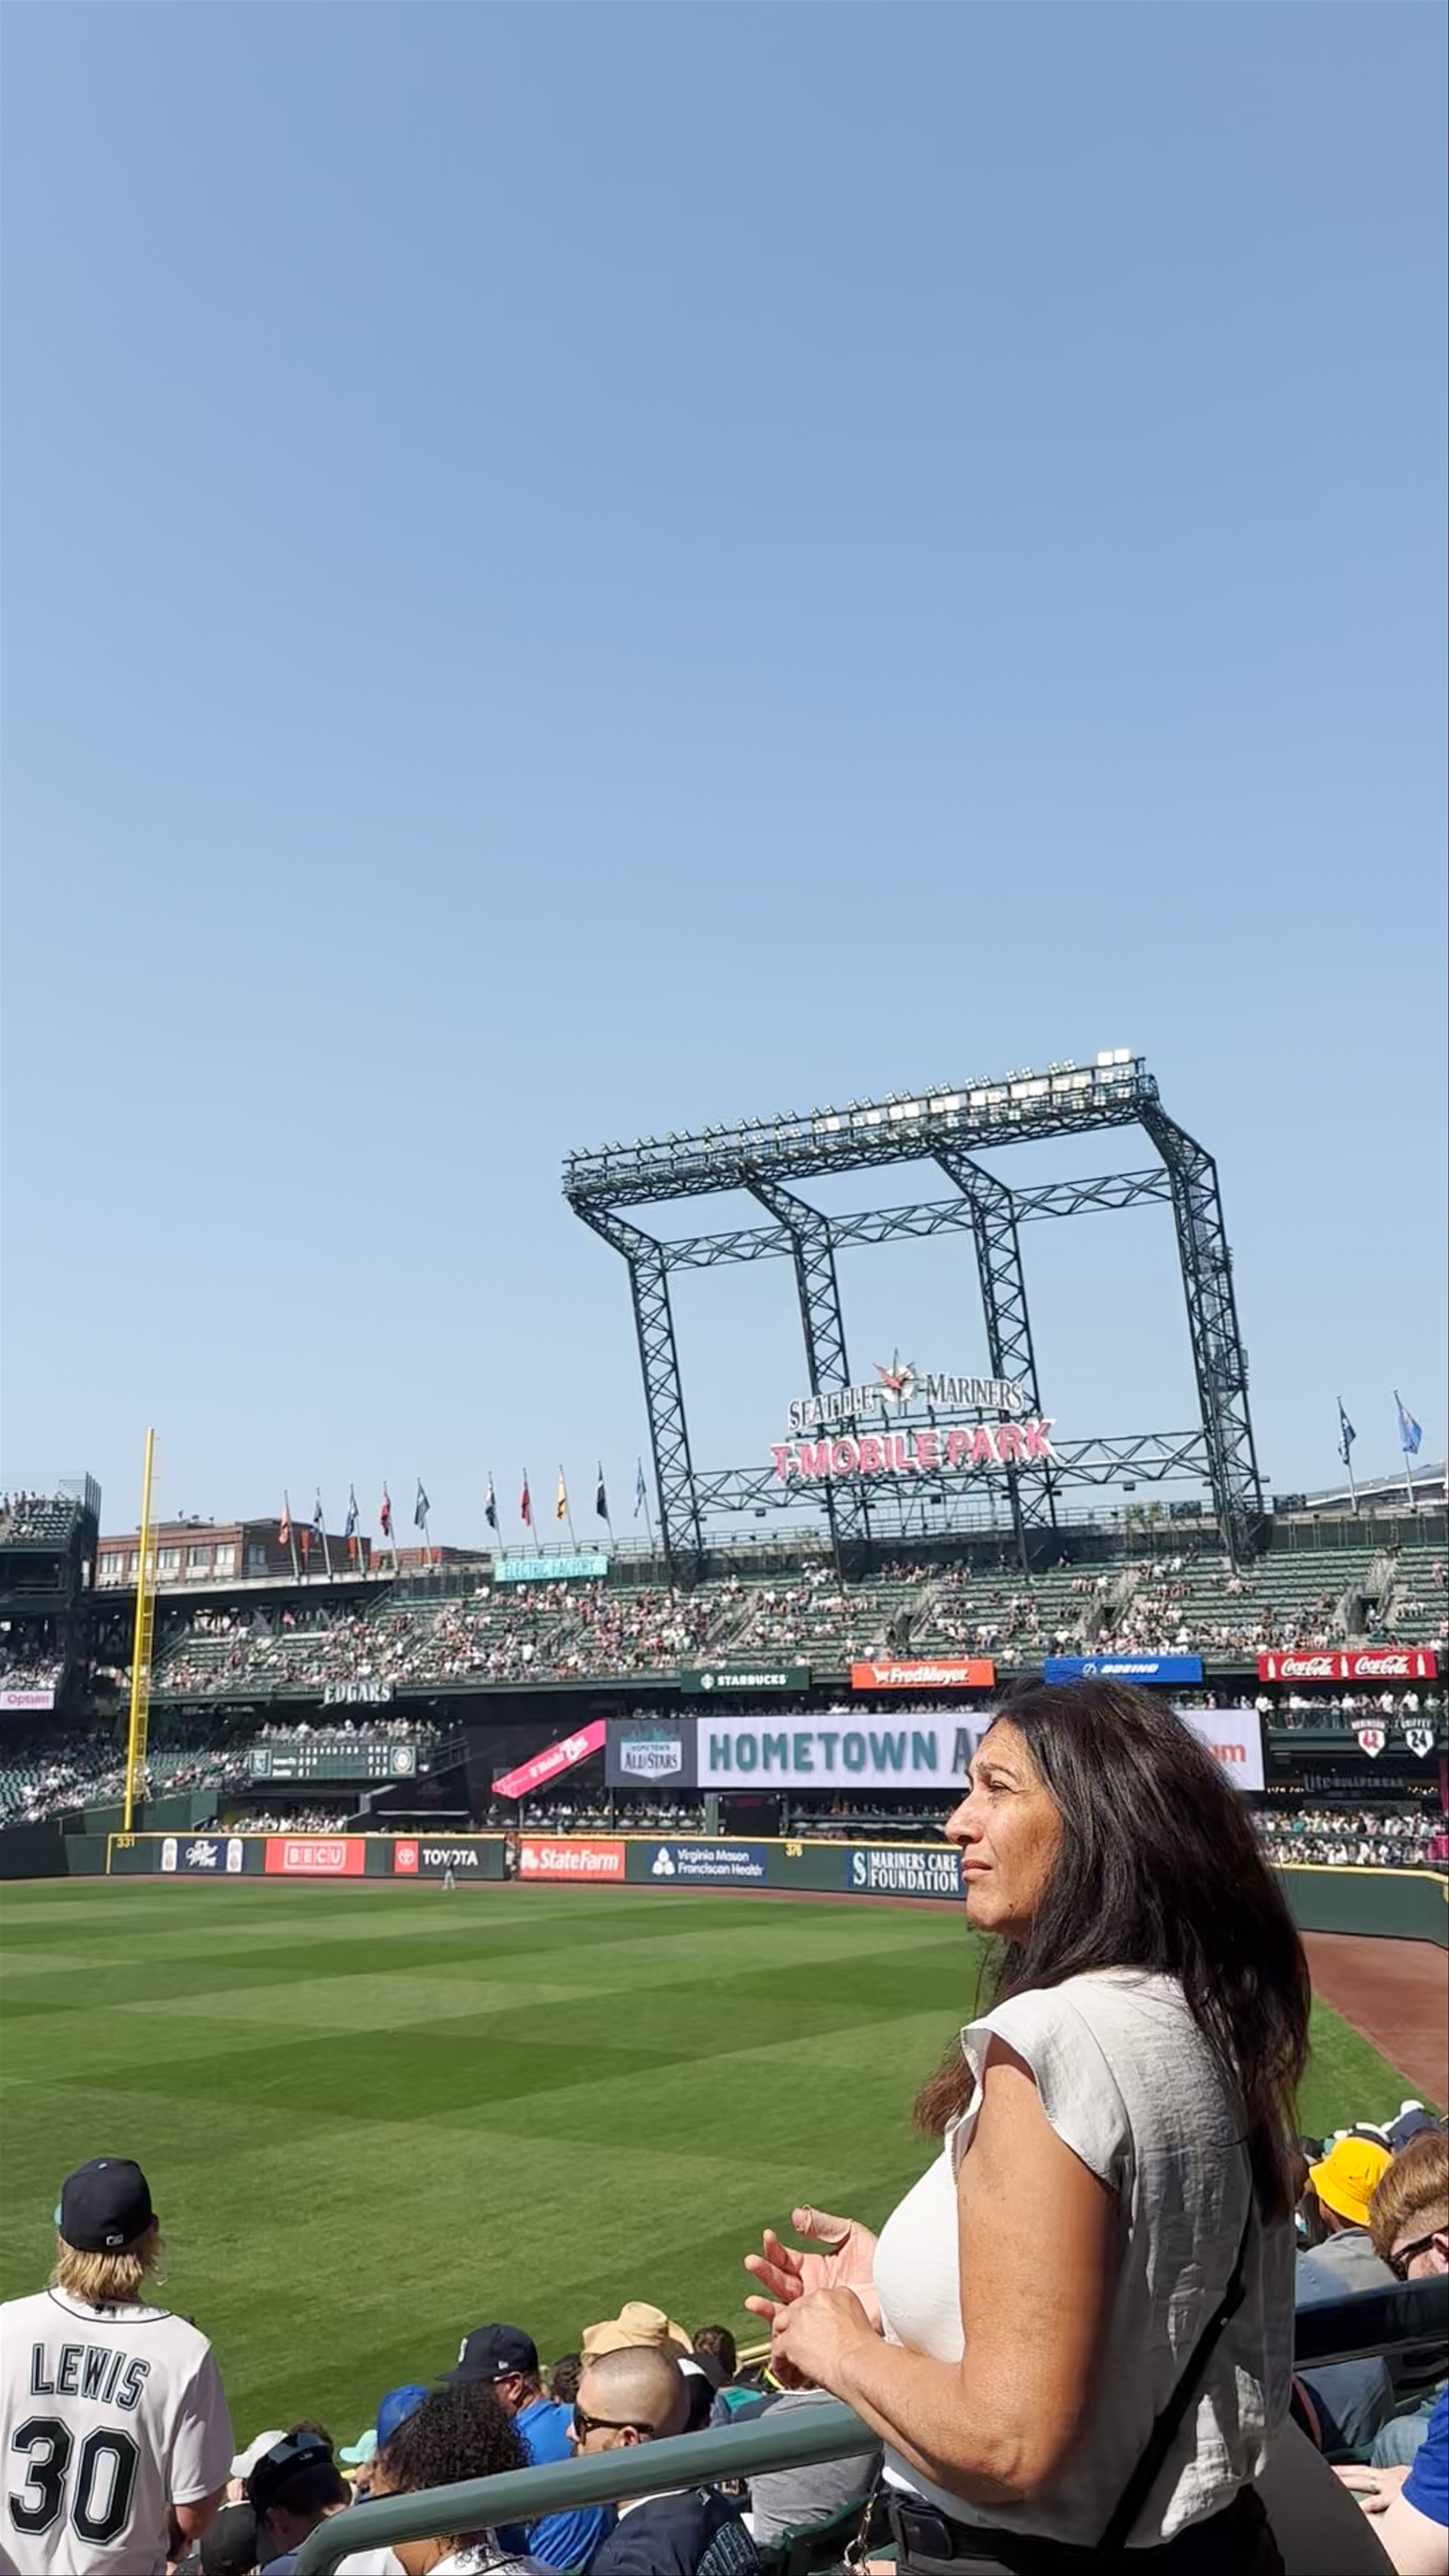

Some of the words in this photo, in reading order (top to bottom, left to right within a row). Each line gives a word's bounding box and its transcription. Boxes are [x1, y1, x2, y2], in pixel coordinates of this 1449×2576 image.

[789, 1386, 875, 1431] SEATTLE
[926, 1373, 1023, 1410] MARINERS
[771, 1429, 941, 1481] T-MOBILE
[947, 1419, 1056, 1466] PARK
[1281, 1657, 1334, 1677] Coca-Cola
[1355, 1655, 1411, 1675] Coca-Cola
[717, 1674, 786, 1686] STARBUCKS
[1412, 1730, 1427, 1748] 24
[710, 1731, 936, 1772] HOMETOWN
[117, 1836, 135, 1848] 331
[289, 1847, 341, 1864] BECU
[423, 1849, 478, 1866] TOYOTA
[678, 1849, 714, 1864] Virginia
[717, 1850, 749, 1862] Mason
[871, 1852, 925, 1870] MARINERS
[928, 1854, 958, 1872] CARE
[678, 1862, 730, 1875] Franciscan
[732, 1864, 763, 1876] Health
[871, 1869, 959, 1892] FOUNDATION
[31, 2343, 151, 2411] LEWIS
[8, 2416, 141, 2545] 30
